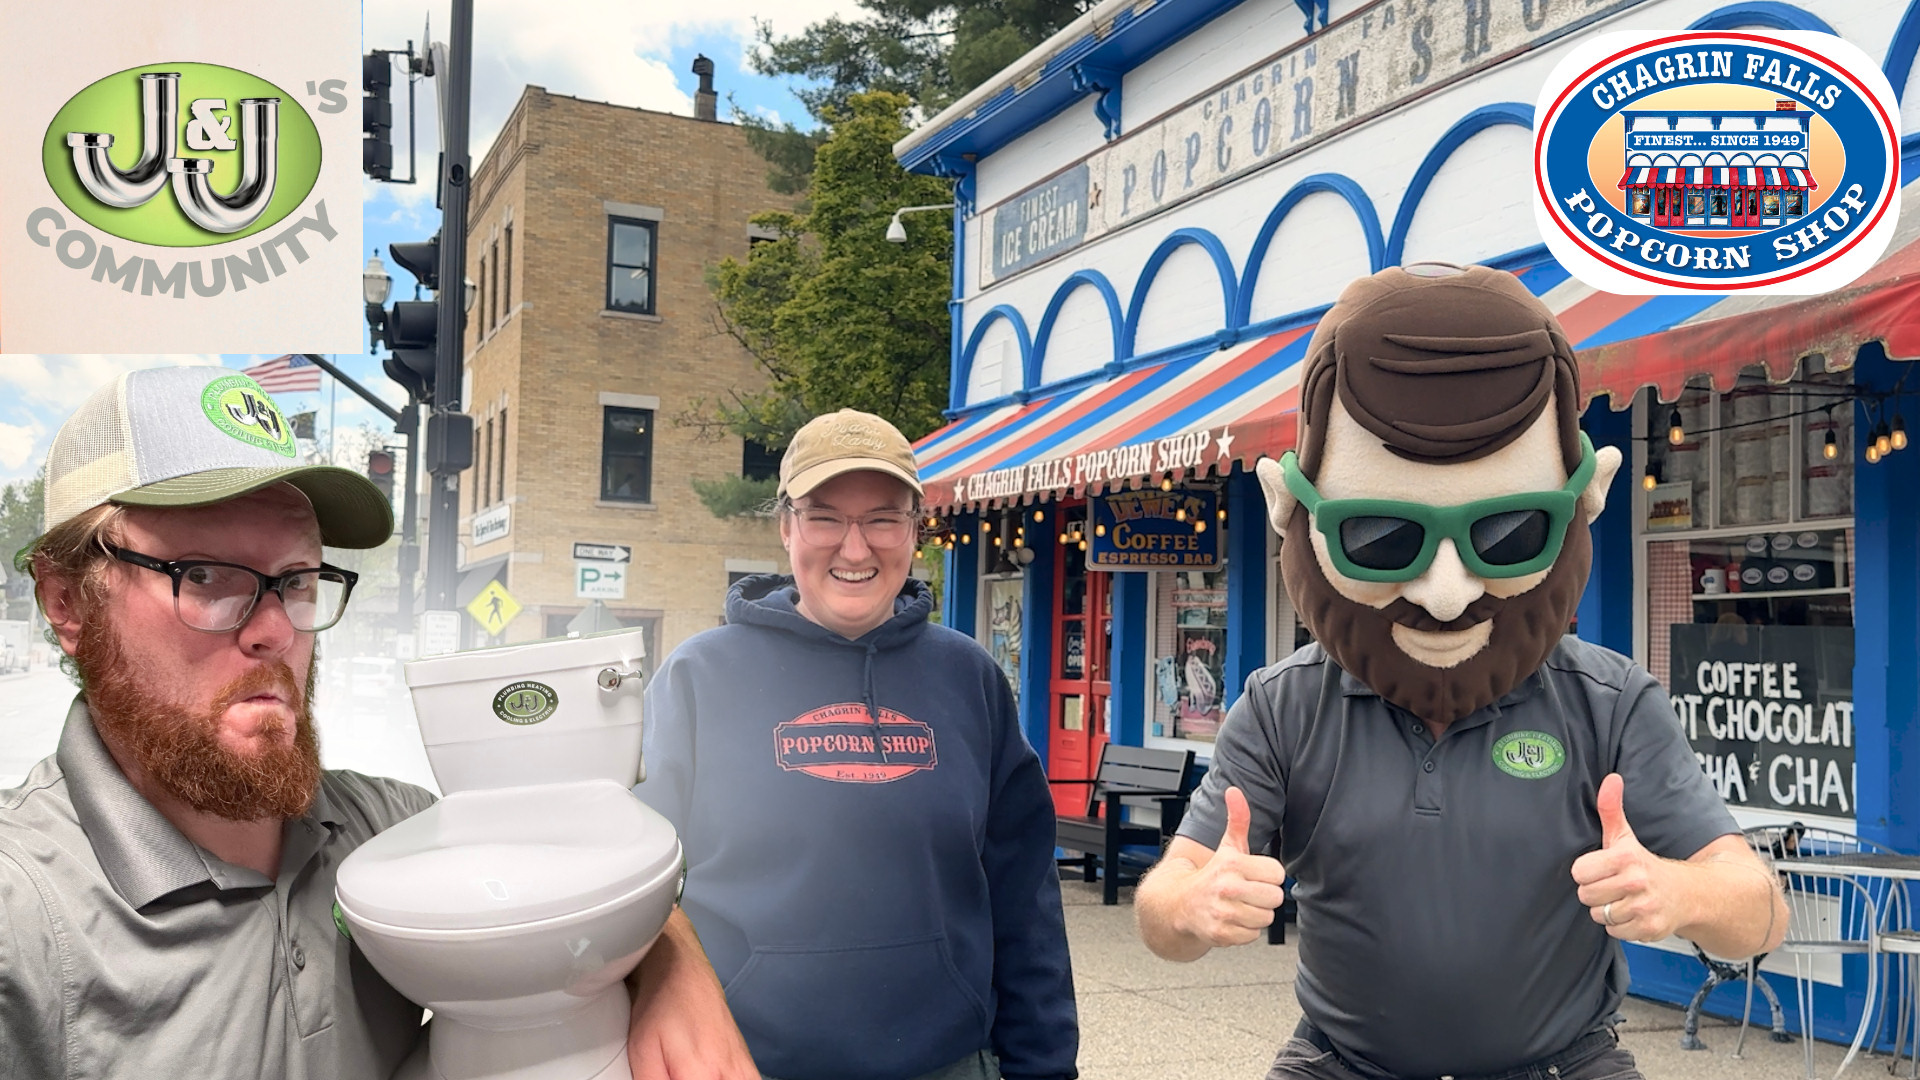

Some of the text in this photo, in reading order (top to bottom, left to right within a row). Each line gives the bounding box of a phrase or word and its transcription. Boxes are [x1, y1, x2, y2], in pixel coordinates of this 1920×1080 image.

[1203, 43, 1318, 121] CHAGRIN
[1120, 49, 1360, 218] POPCORN
[1019, 185, 1060, 224] FINEST
[1001, 200, 1079, 269] ICE CREAM
[832, 433, 887, 451] Lady
[967, 430, 1211, 501] CHAGRIN FALLS POPCORN SHOP
[1112, 522, 1200, 551] COFFEE
[579, 547, 614, 558] ONE WAY
[1098, 552, 1213, 565] ESPRESSO BAR
[498, 683, 553, 701] PLUMBING HEATING
[1697, 660, 1802, 699] COFFEE
[500, 710, 524, 723] COOLING
[529, 706, 553, 723] ELECTRIC
[812, 707, 862, 722] CHAGRIN
[1670, 693, 1855, 748] OT CHOCOLAT
[782, 734, 931, 755] POPCORN SHOP
[863, 771, 887, 780] 1949
[1768, 754, 1857, 814] CHA
